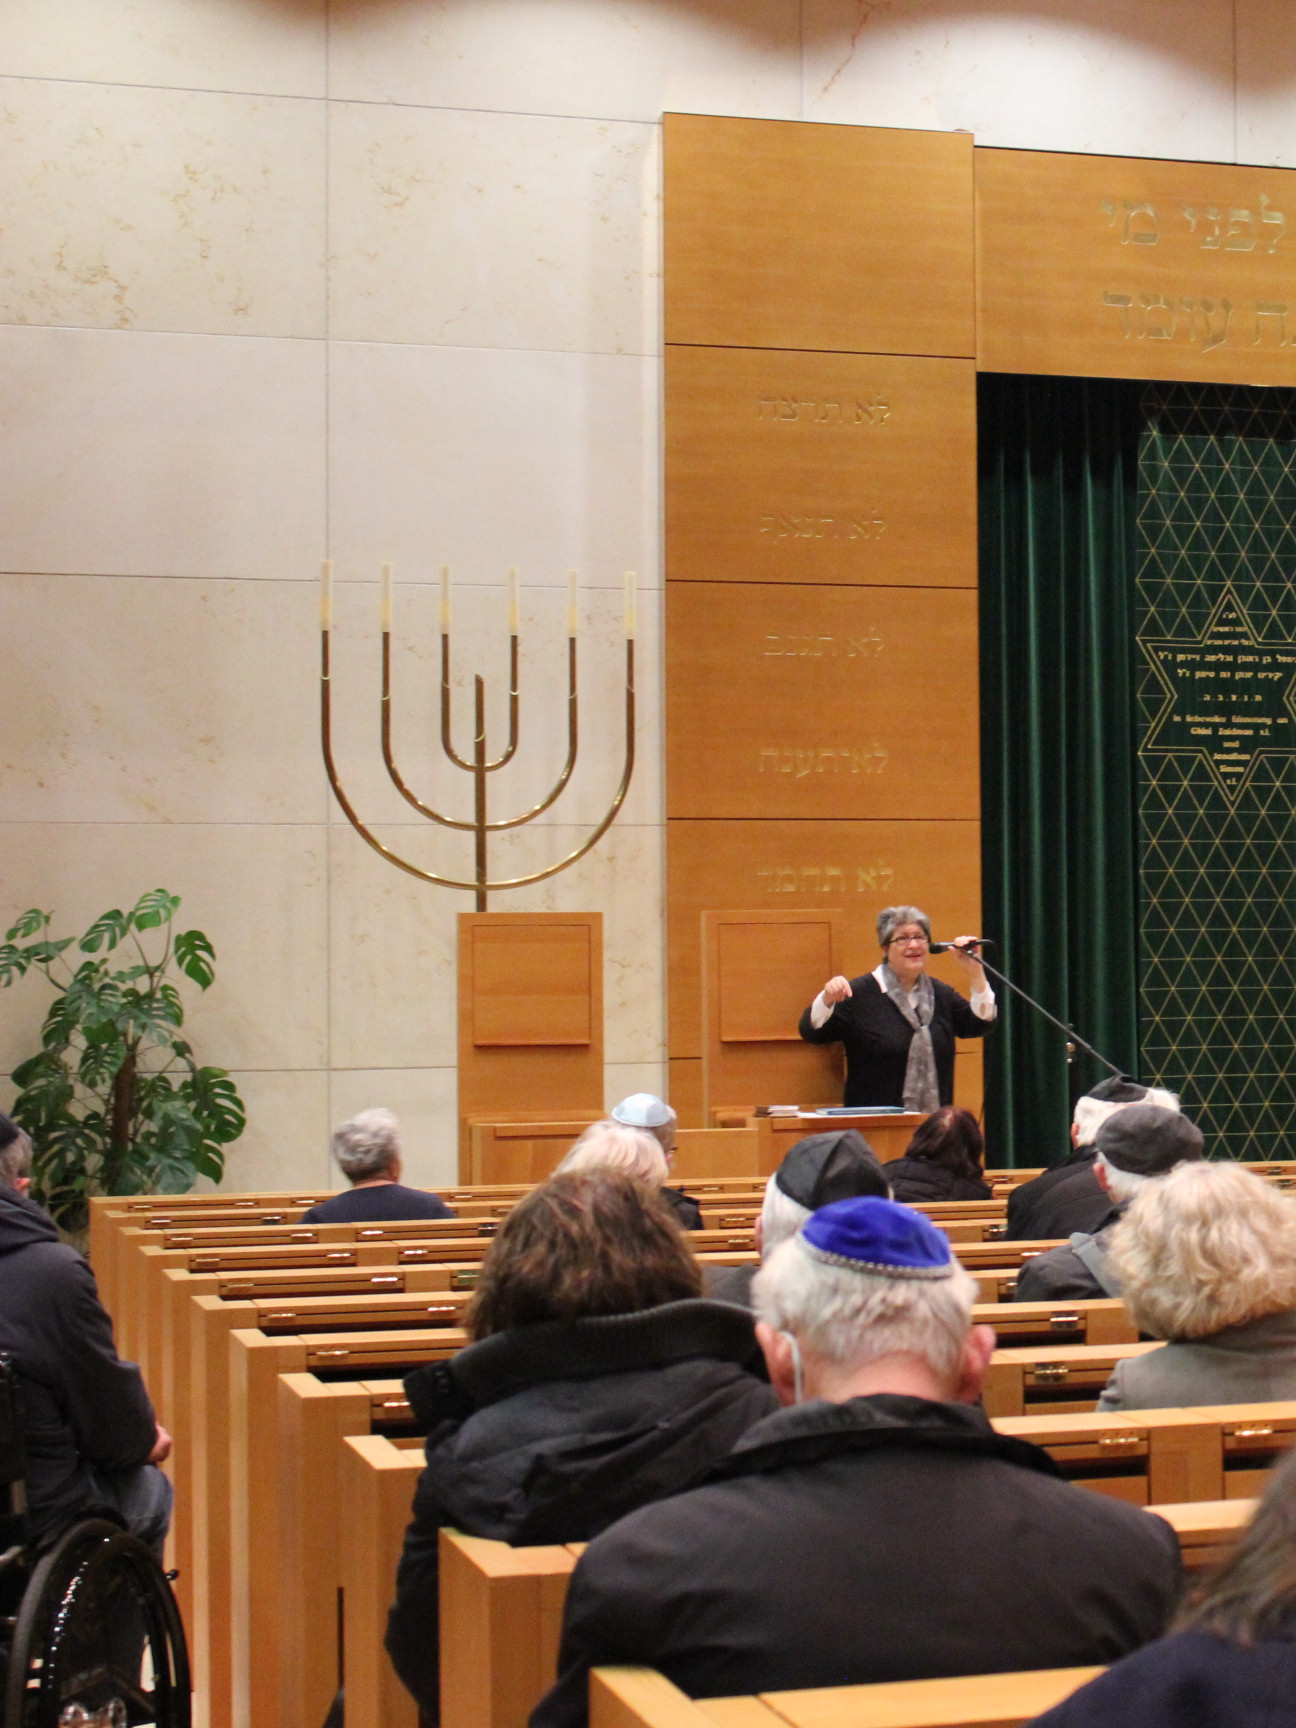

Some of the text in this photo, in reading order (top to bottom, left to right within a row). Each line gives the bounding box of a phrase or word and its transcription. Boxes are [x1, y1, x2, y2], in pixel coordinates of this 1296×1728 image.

[1100, 197, 1160, 246] מי
[1181, 192, 1287, 255] לפני
[1102, 289, 1233, 354] עומד
[758, 393, 891, 425] לא תרצח
[849, 507, 887, 540] לא
[756, 859, 894, 892] לא תחמד
